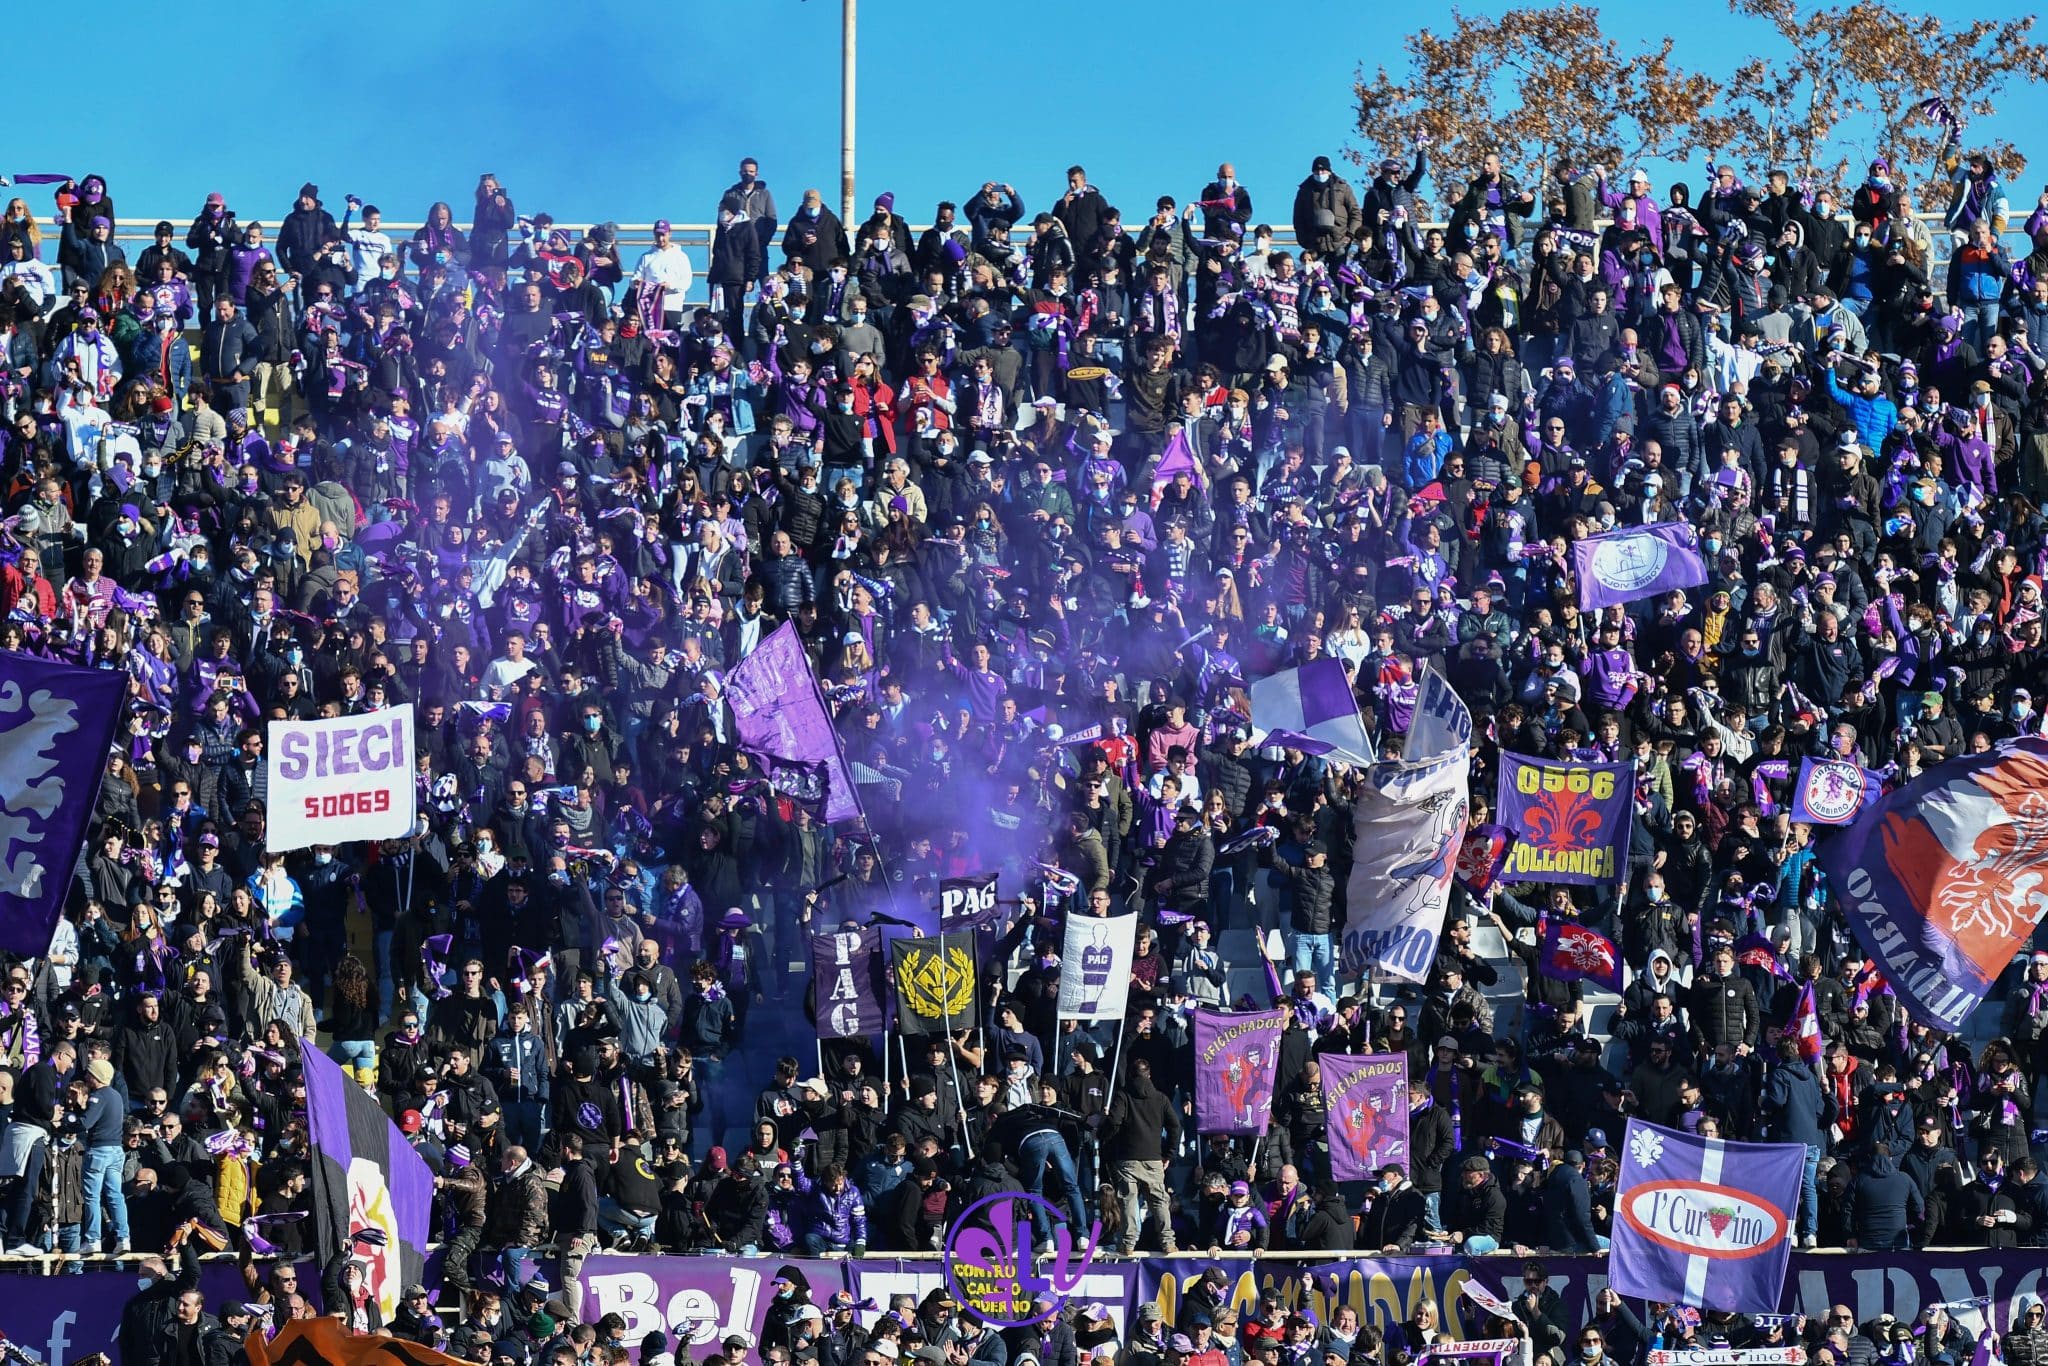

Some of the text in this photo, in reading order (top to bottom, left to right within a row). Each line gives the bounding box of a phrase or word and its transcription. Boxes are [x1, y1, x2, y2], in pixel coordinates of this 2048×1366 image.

[280, 718, 404, 780] SIECI
[1517, 764, 1615, 800] 0566
[941, 880, 997, 919] PAG
[1087, 954, 1109, 965] PAG
[1202, 1017, 1283, 1065] AFICIONADOS
[1326, 1061, 1404, 1112] AFICIONADOS
[966, 1281, 1021, 1296] CALO
